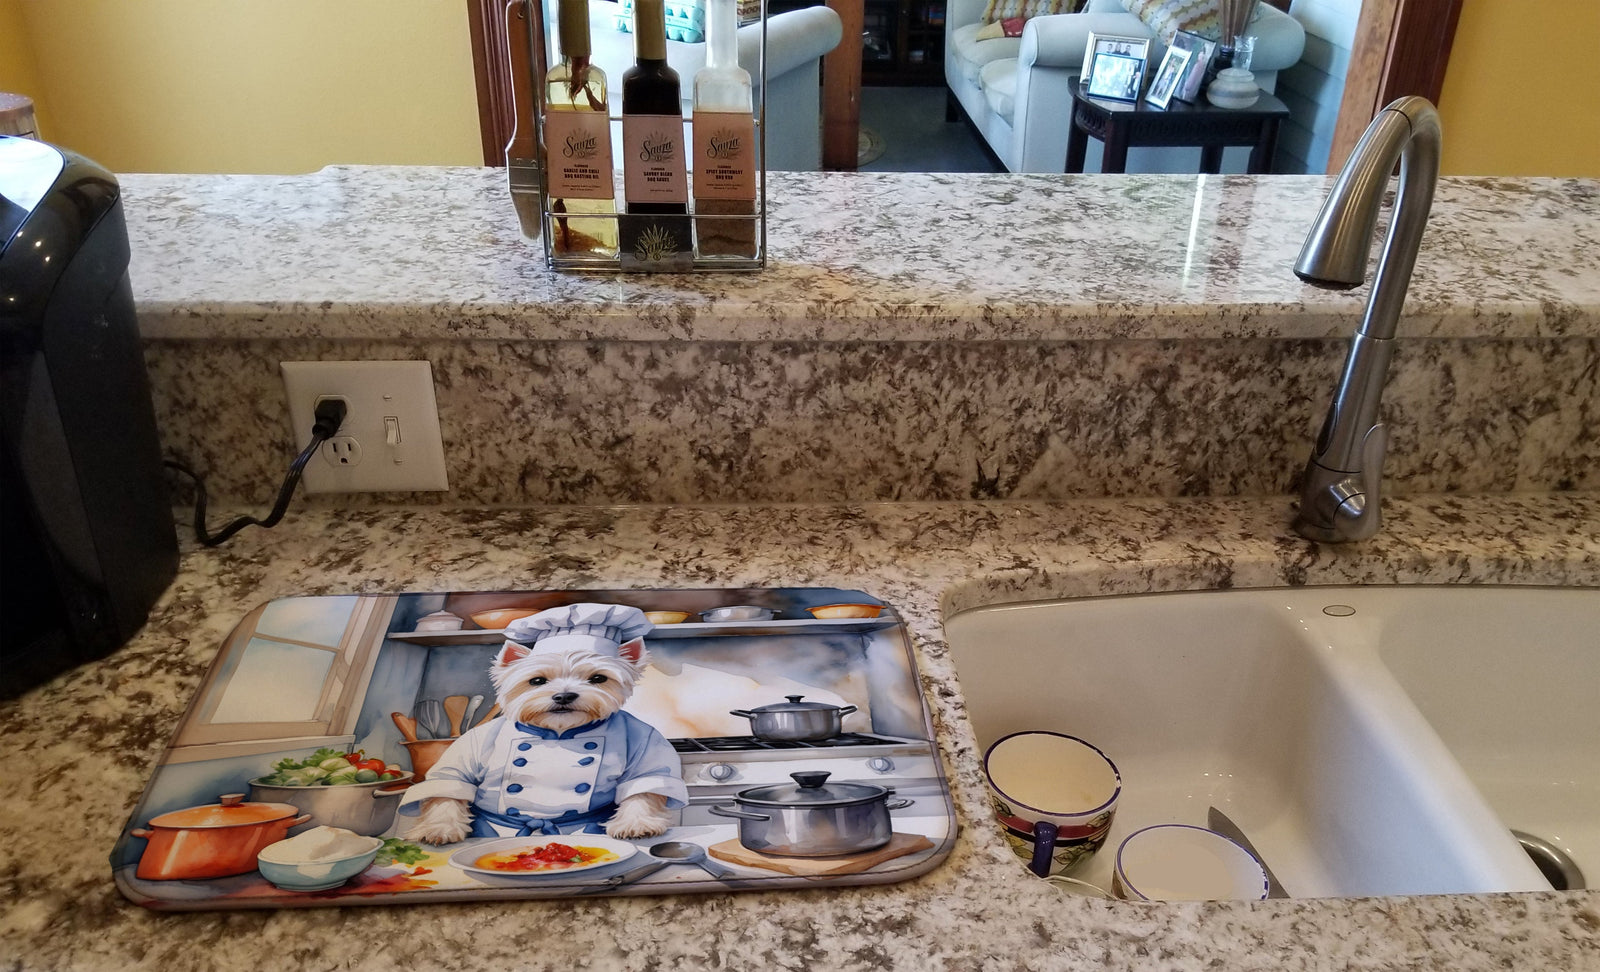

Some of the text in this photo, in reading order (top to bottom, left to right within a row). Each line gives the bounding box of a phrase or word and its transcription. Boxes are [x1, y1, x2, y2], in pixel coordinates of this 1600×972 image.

[563, 136, 597, 158] Sauza
[640, 140, 673, 161] Sauza
[707, 136, 740, 158] Sauza
